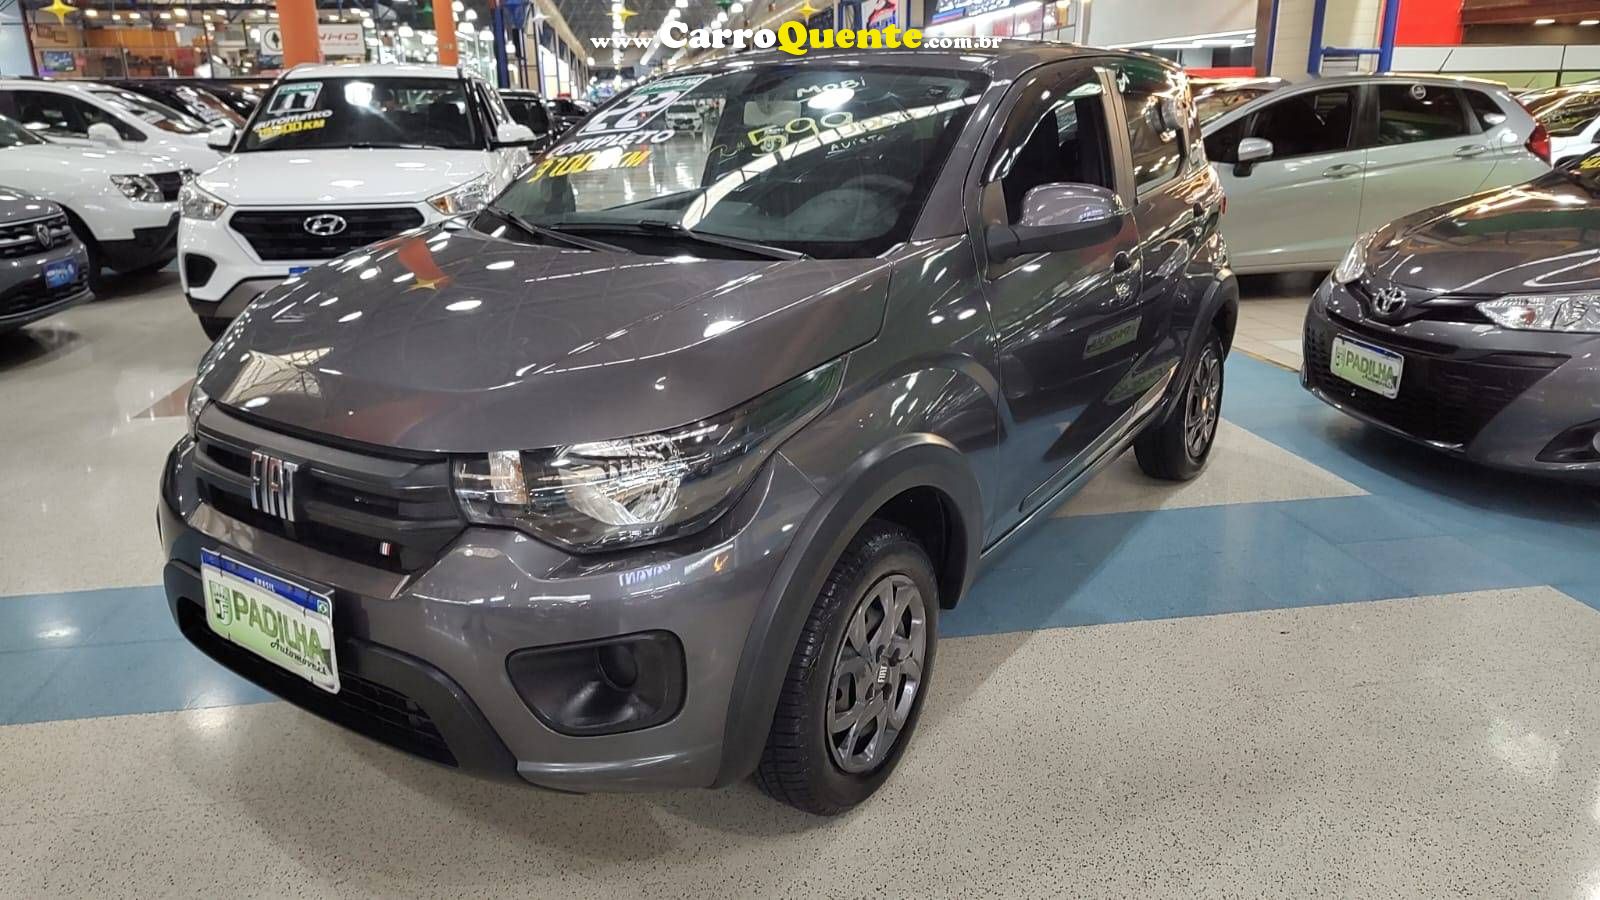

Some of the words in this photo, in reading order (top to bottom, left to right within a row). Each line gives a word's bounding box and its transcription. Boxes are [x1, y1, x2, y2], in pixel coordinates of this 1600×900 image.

[584, 90, 682, 131] 22
[545, 129, 676, 160] COMPLETO
[1346, 350, 1394, 382] PADILHA
[250, 450, 299, 522] FIAT
[232, 589, 326, 664] PADILHA
[877, 664, 888, 683] FIAT
